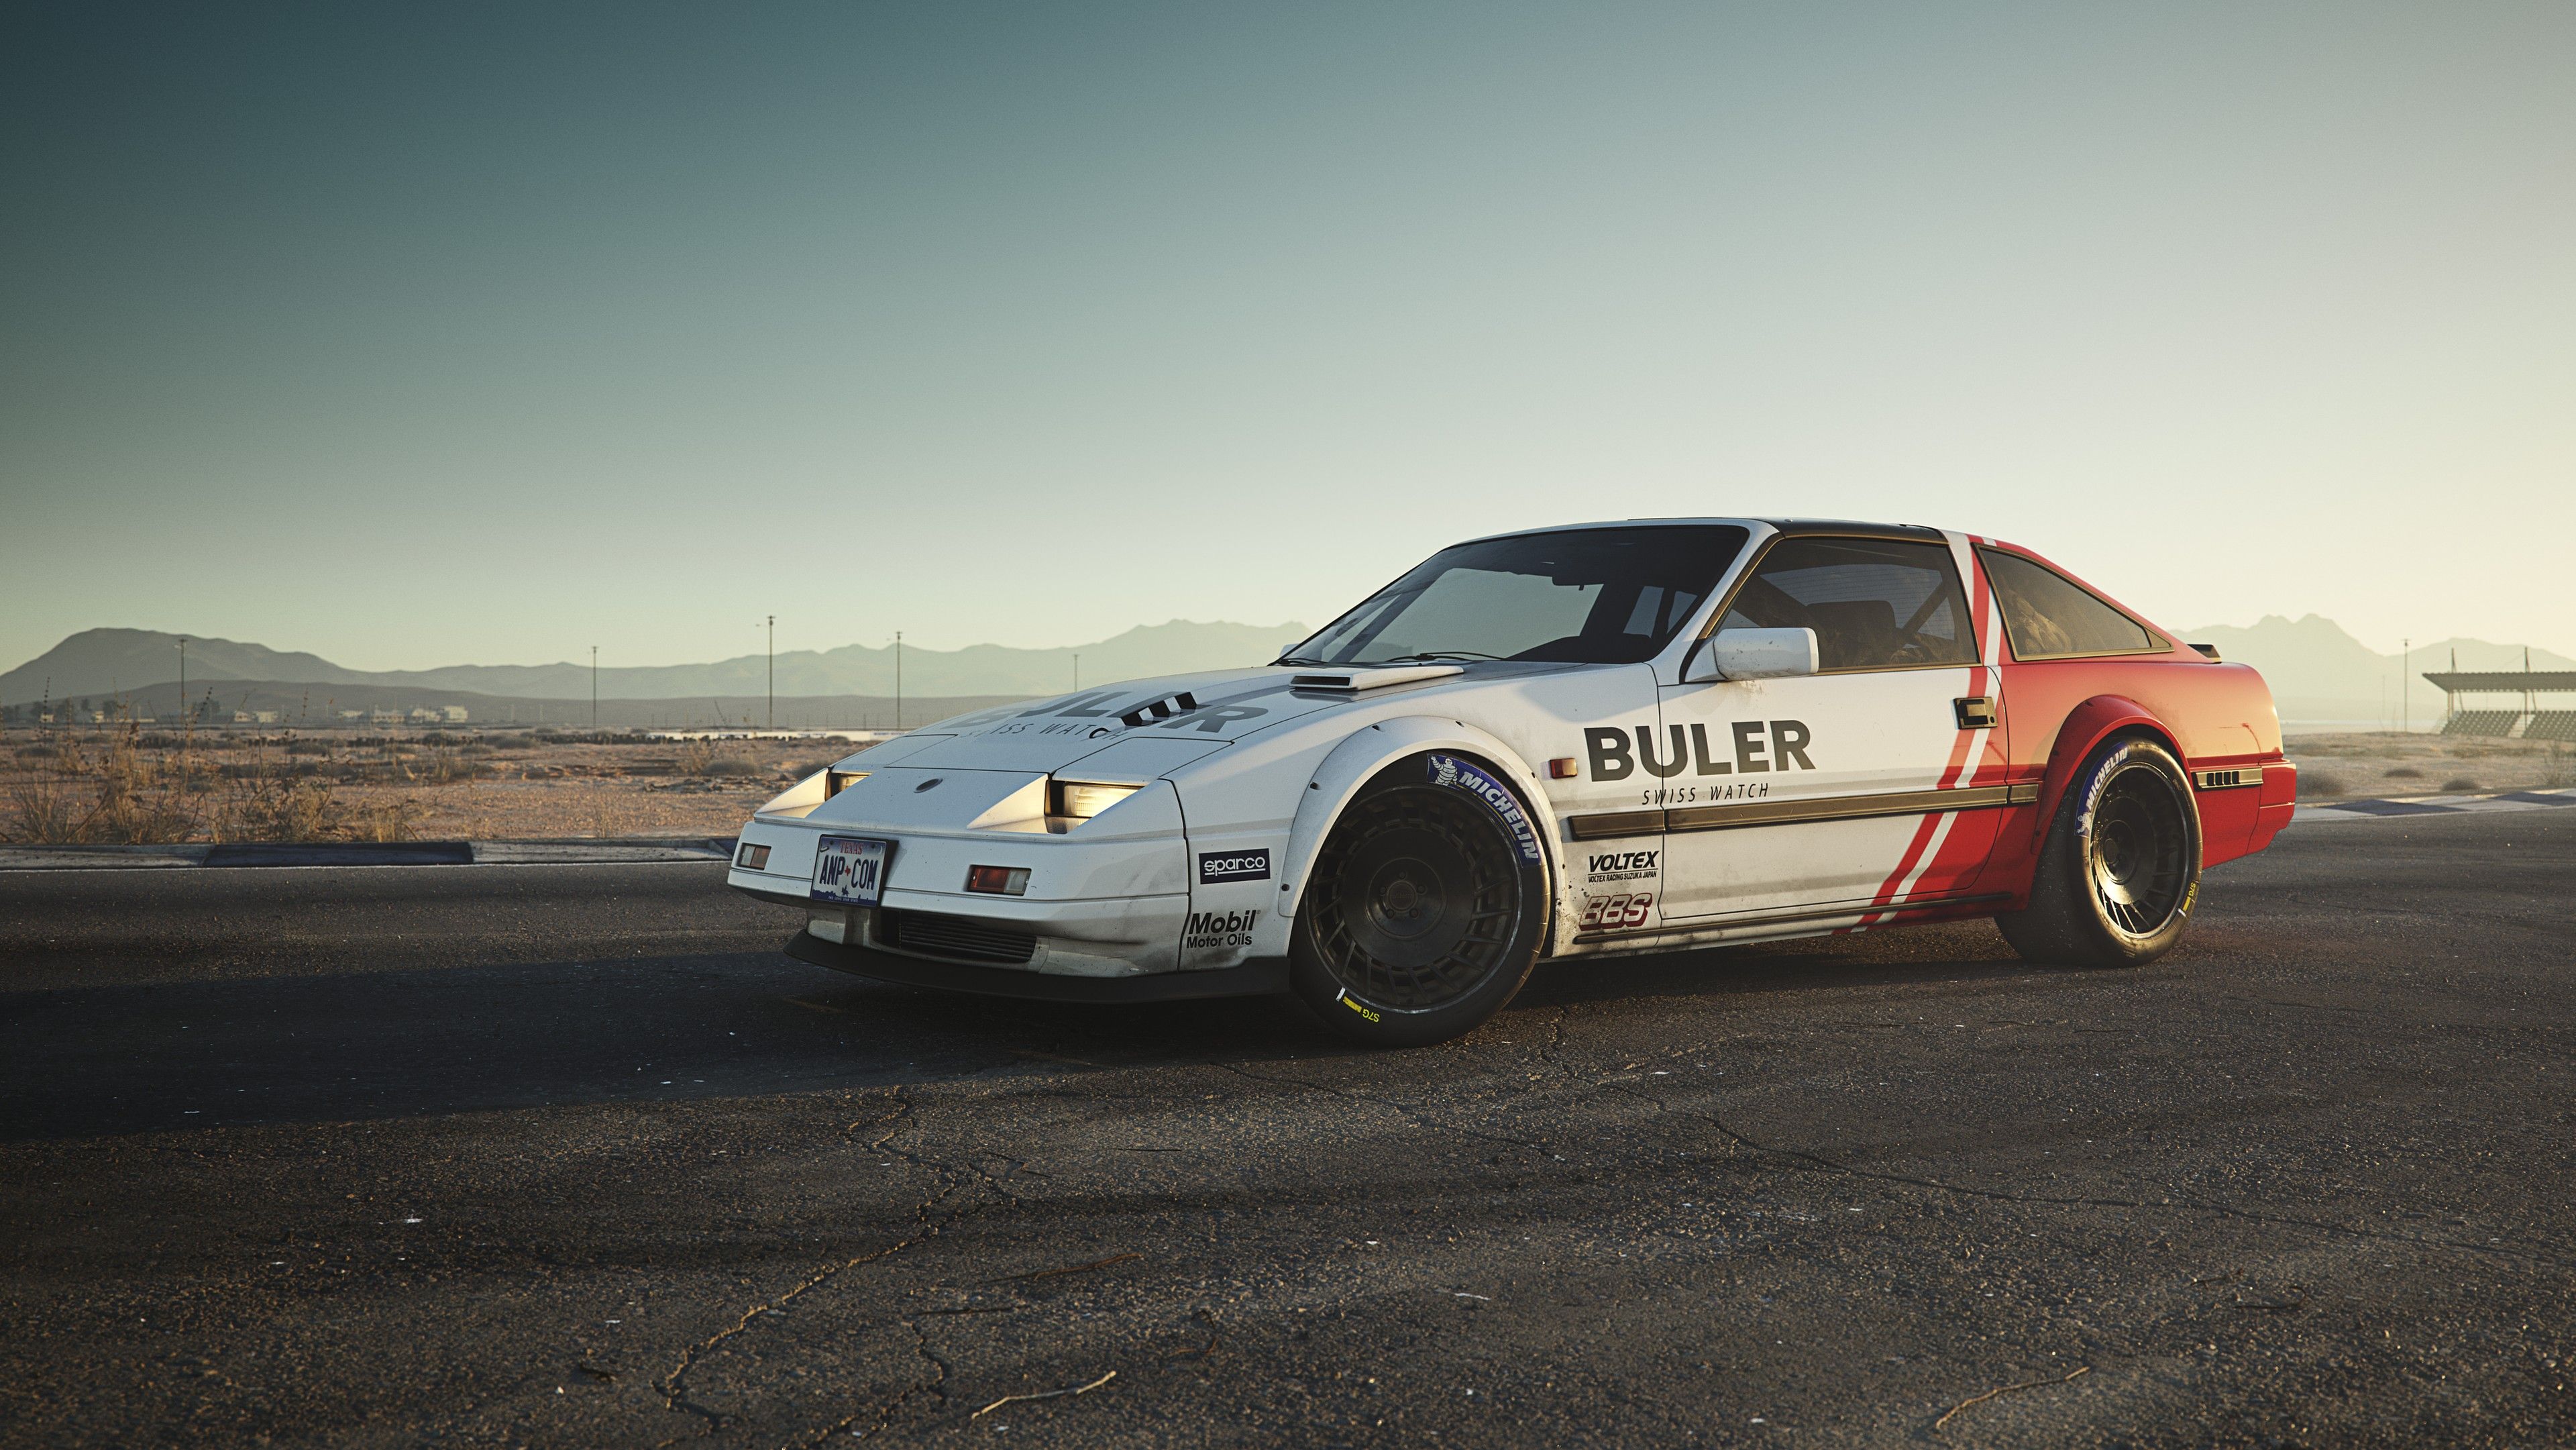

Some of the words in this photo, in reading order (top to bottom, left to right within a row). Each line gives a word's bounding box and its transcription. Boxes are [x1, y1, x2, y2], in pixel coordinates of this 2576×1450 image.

[1584, 719, 1816, 782] BULER
[2086, 747, 2128, 811] MICHELIN
[1642, 787, 1696, 805] SWISS
[1711, 783, 1768, 800] WATCH
[1459, 772, 1538, 859] MICHELIN
[840, 841, 863, 854] TEXAS
[1204, 856, 1265, 876] sparco
[1589, 850, 1660, 872] VOLTEX
[851, 858, 878, 890] COM
[1588, 875, 1605, 883] VOLTEX
[1624, 872, 1642, 880] SUZUKA
[1643, 870, 1657, 878] JAPAN
[1188, 910, 1257, 935] Mobil
[1578, 892, 1652, 931] BBS
[1187, 936, 1224, 948] Motor
[1227, 933, 1252, 945] Oils
[1362, 1008, 1380, 1023] S7G
